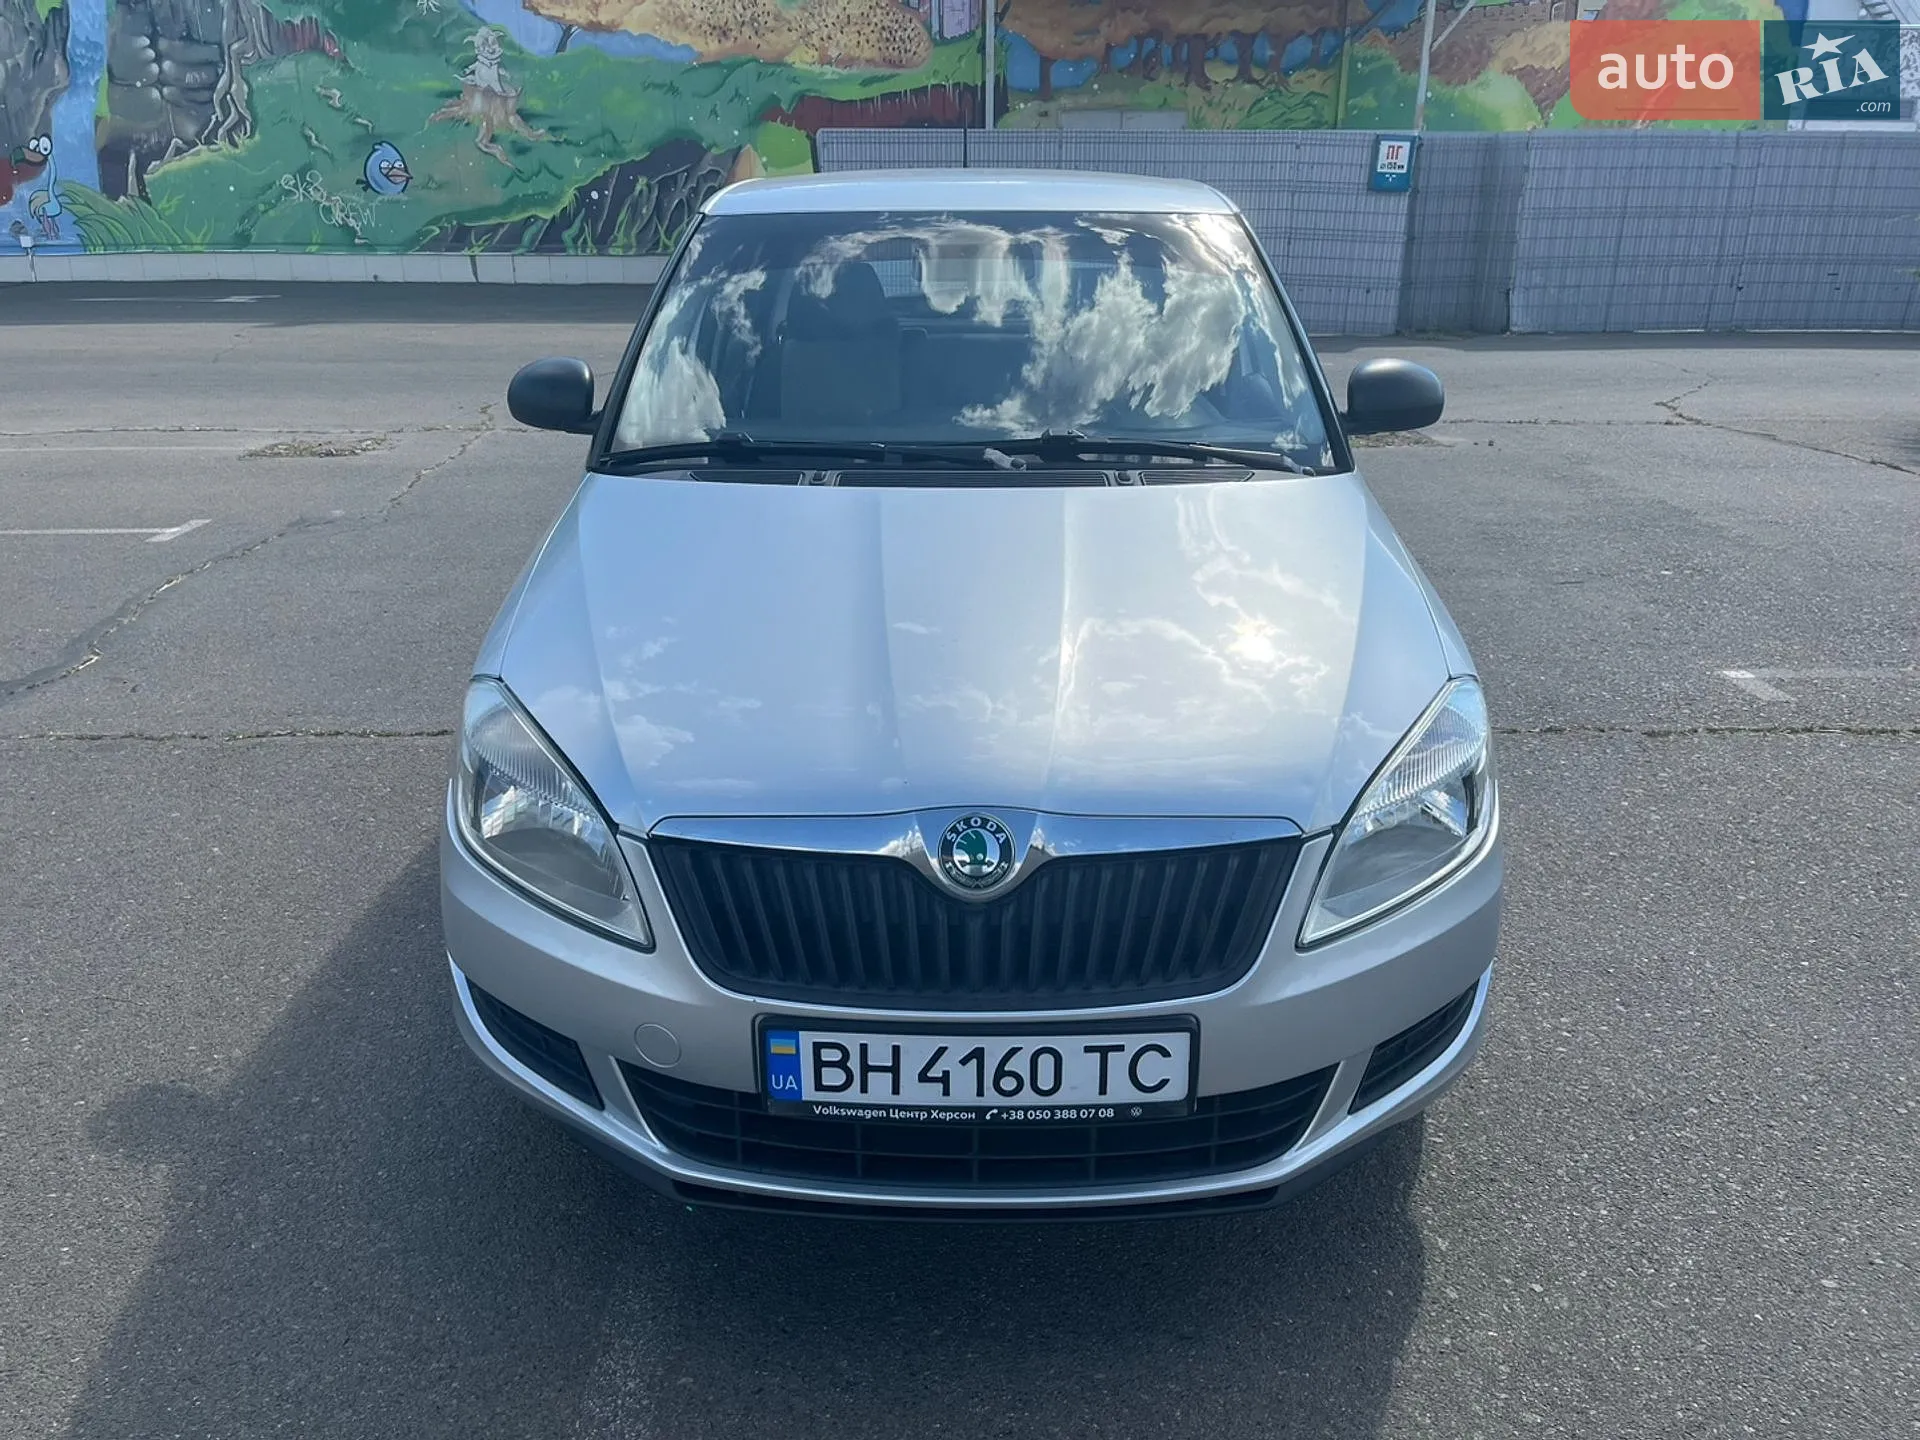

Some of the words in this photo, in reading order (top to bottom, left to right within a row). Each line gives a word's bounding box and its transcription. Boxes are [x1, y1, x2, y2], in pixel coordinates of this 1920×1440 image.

[812, 1041, 900, 1095] BH
[917, 1046, 1063, 1097] 4160
[1083, 1043, 1172, 1096] TC
[771, 1074, 798, 1090] UA
[813, 1104, 886, 1118] Volkswagen
[889, 1108, 927, 1120] Центр
[930, 1109, 976, 1120] Херсон
[1001, 1109, 1024, 1120] +38
[1026, 1109, 1051, 1120] 050
[1053, 1109, 1077, 1119] 388
[1079, 1108, 1096, 1119] 07
[1098, 1107, 1115, 1118] 08
